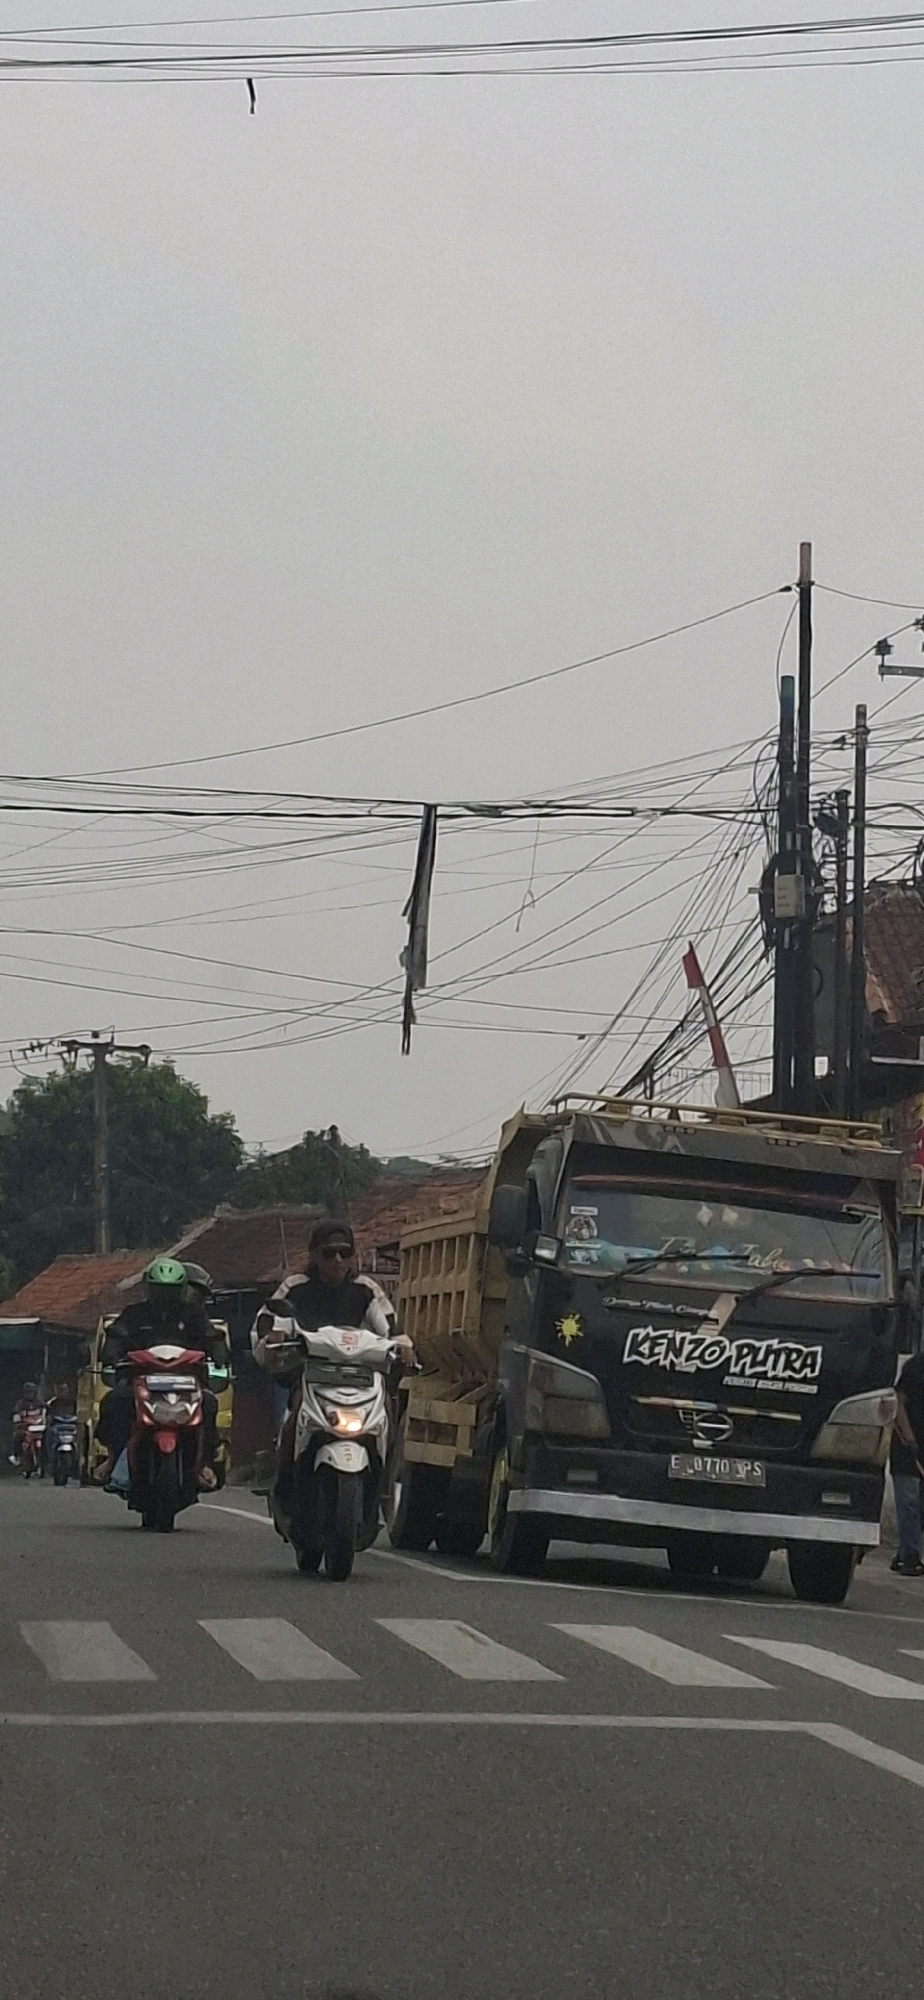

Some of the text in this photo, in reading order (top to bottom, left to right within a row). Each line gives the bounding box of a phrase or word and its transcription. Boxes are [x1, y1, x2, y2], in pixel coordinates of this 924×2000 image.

[623, 1326, 822, 1378] KENZO PUTRA
[671, 1454, 681, 1469] E
